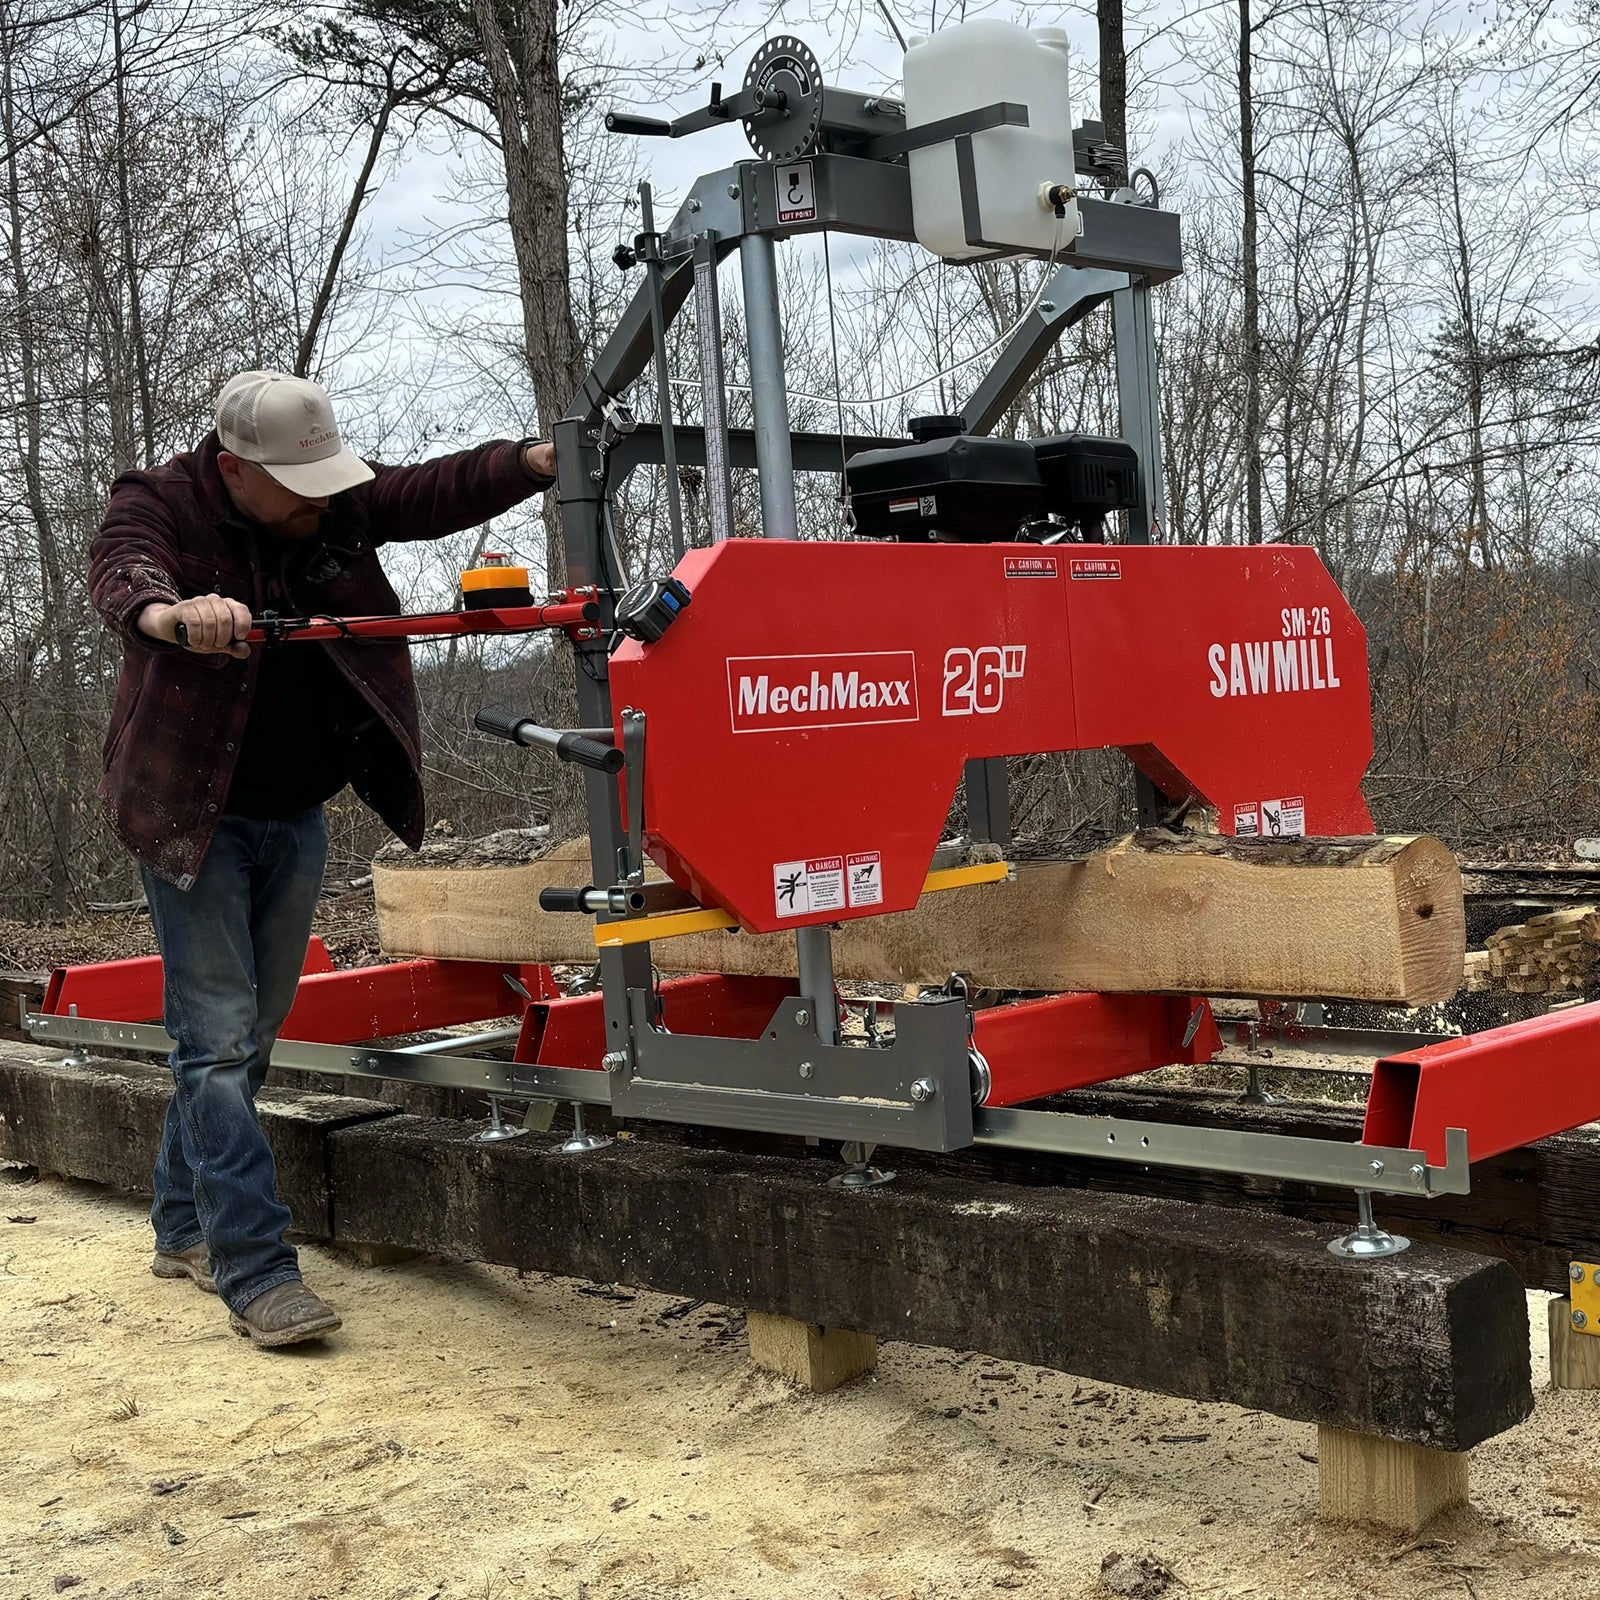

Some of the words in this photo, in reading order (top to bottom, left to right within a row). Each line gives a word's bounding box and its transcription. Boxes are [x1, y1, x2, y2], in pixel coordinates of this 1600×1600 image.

[781, 212, 794, 220] LIFT
[795, 210, 812, 219] POINT
[1018, 560, 1043, 569] CAUTION
[1083, 562, 1107, 571] CAUTION
[1208, 638, 1340, 698] SAWMILL
[942, 645, 1027, 717] 26"
[738, 671, 910, 715] MechMaxx
[815, 860, 840, 871] DANGER
